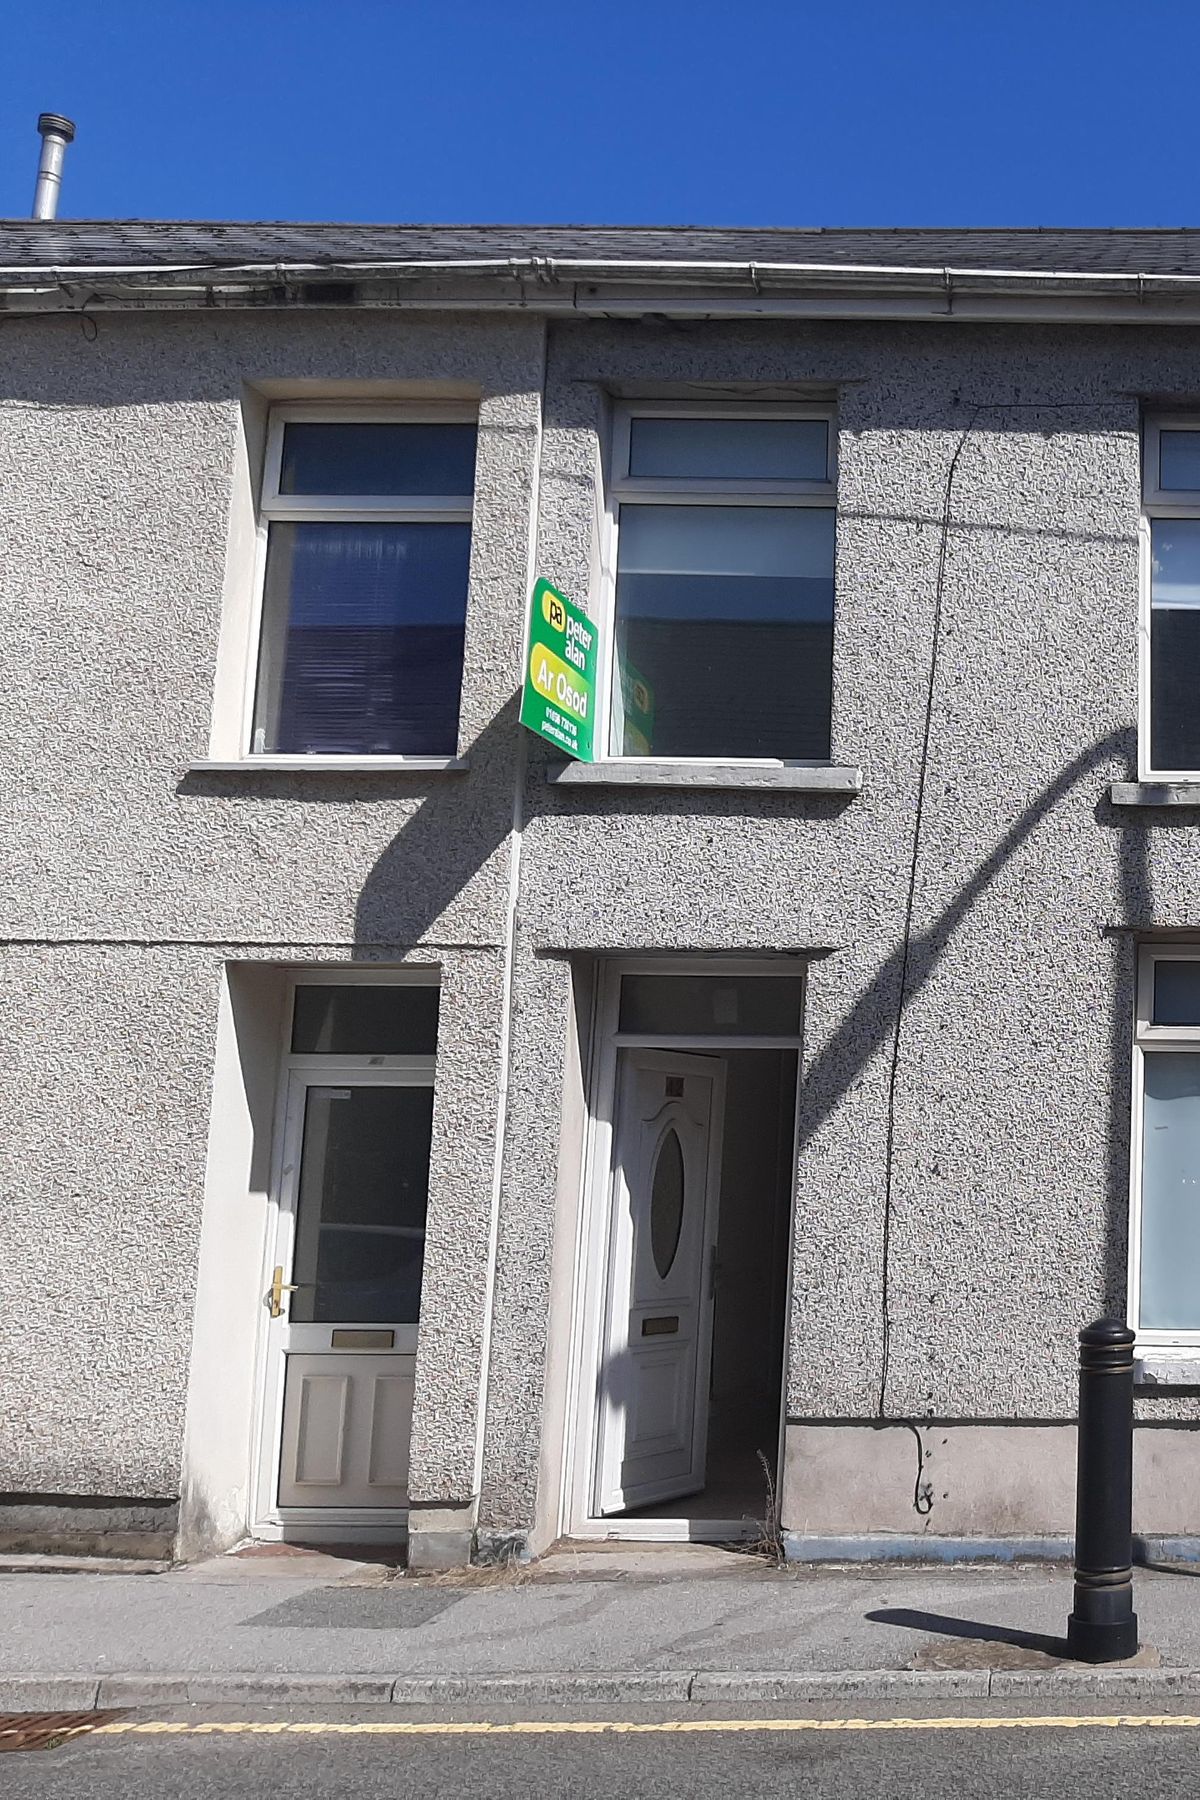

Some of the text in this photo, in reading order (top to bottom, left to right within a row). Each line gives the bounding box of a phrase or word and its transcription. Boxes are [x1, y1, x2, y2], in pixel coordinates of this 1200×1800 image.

[549, 599, 562, 626] pa
[566, 615, 592, 651] peter
[565, 640, 585, 671] alan
[538, 660, 553, 691] Ar
[556, 672, 588, 719] Osod
